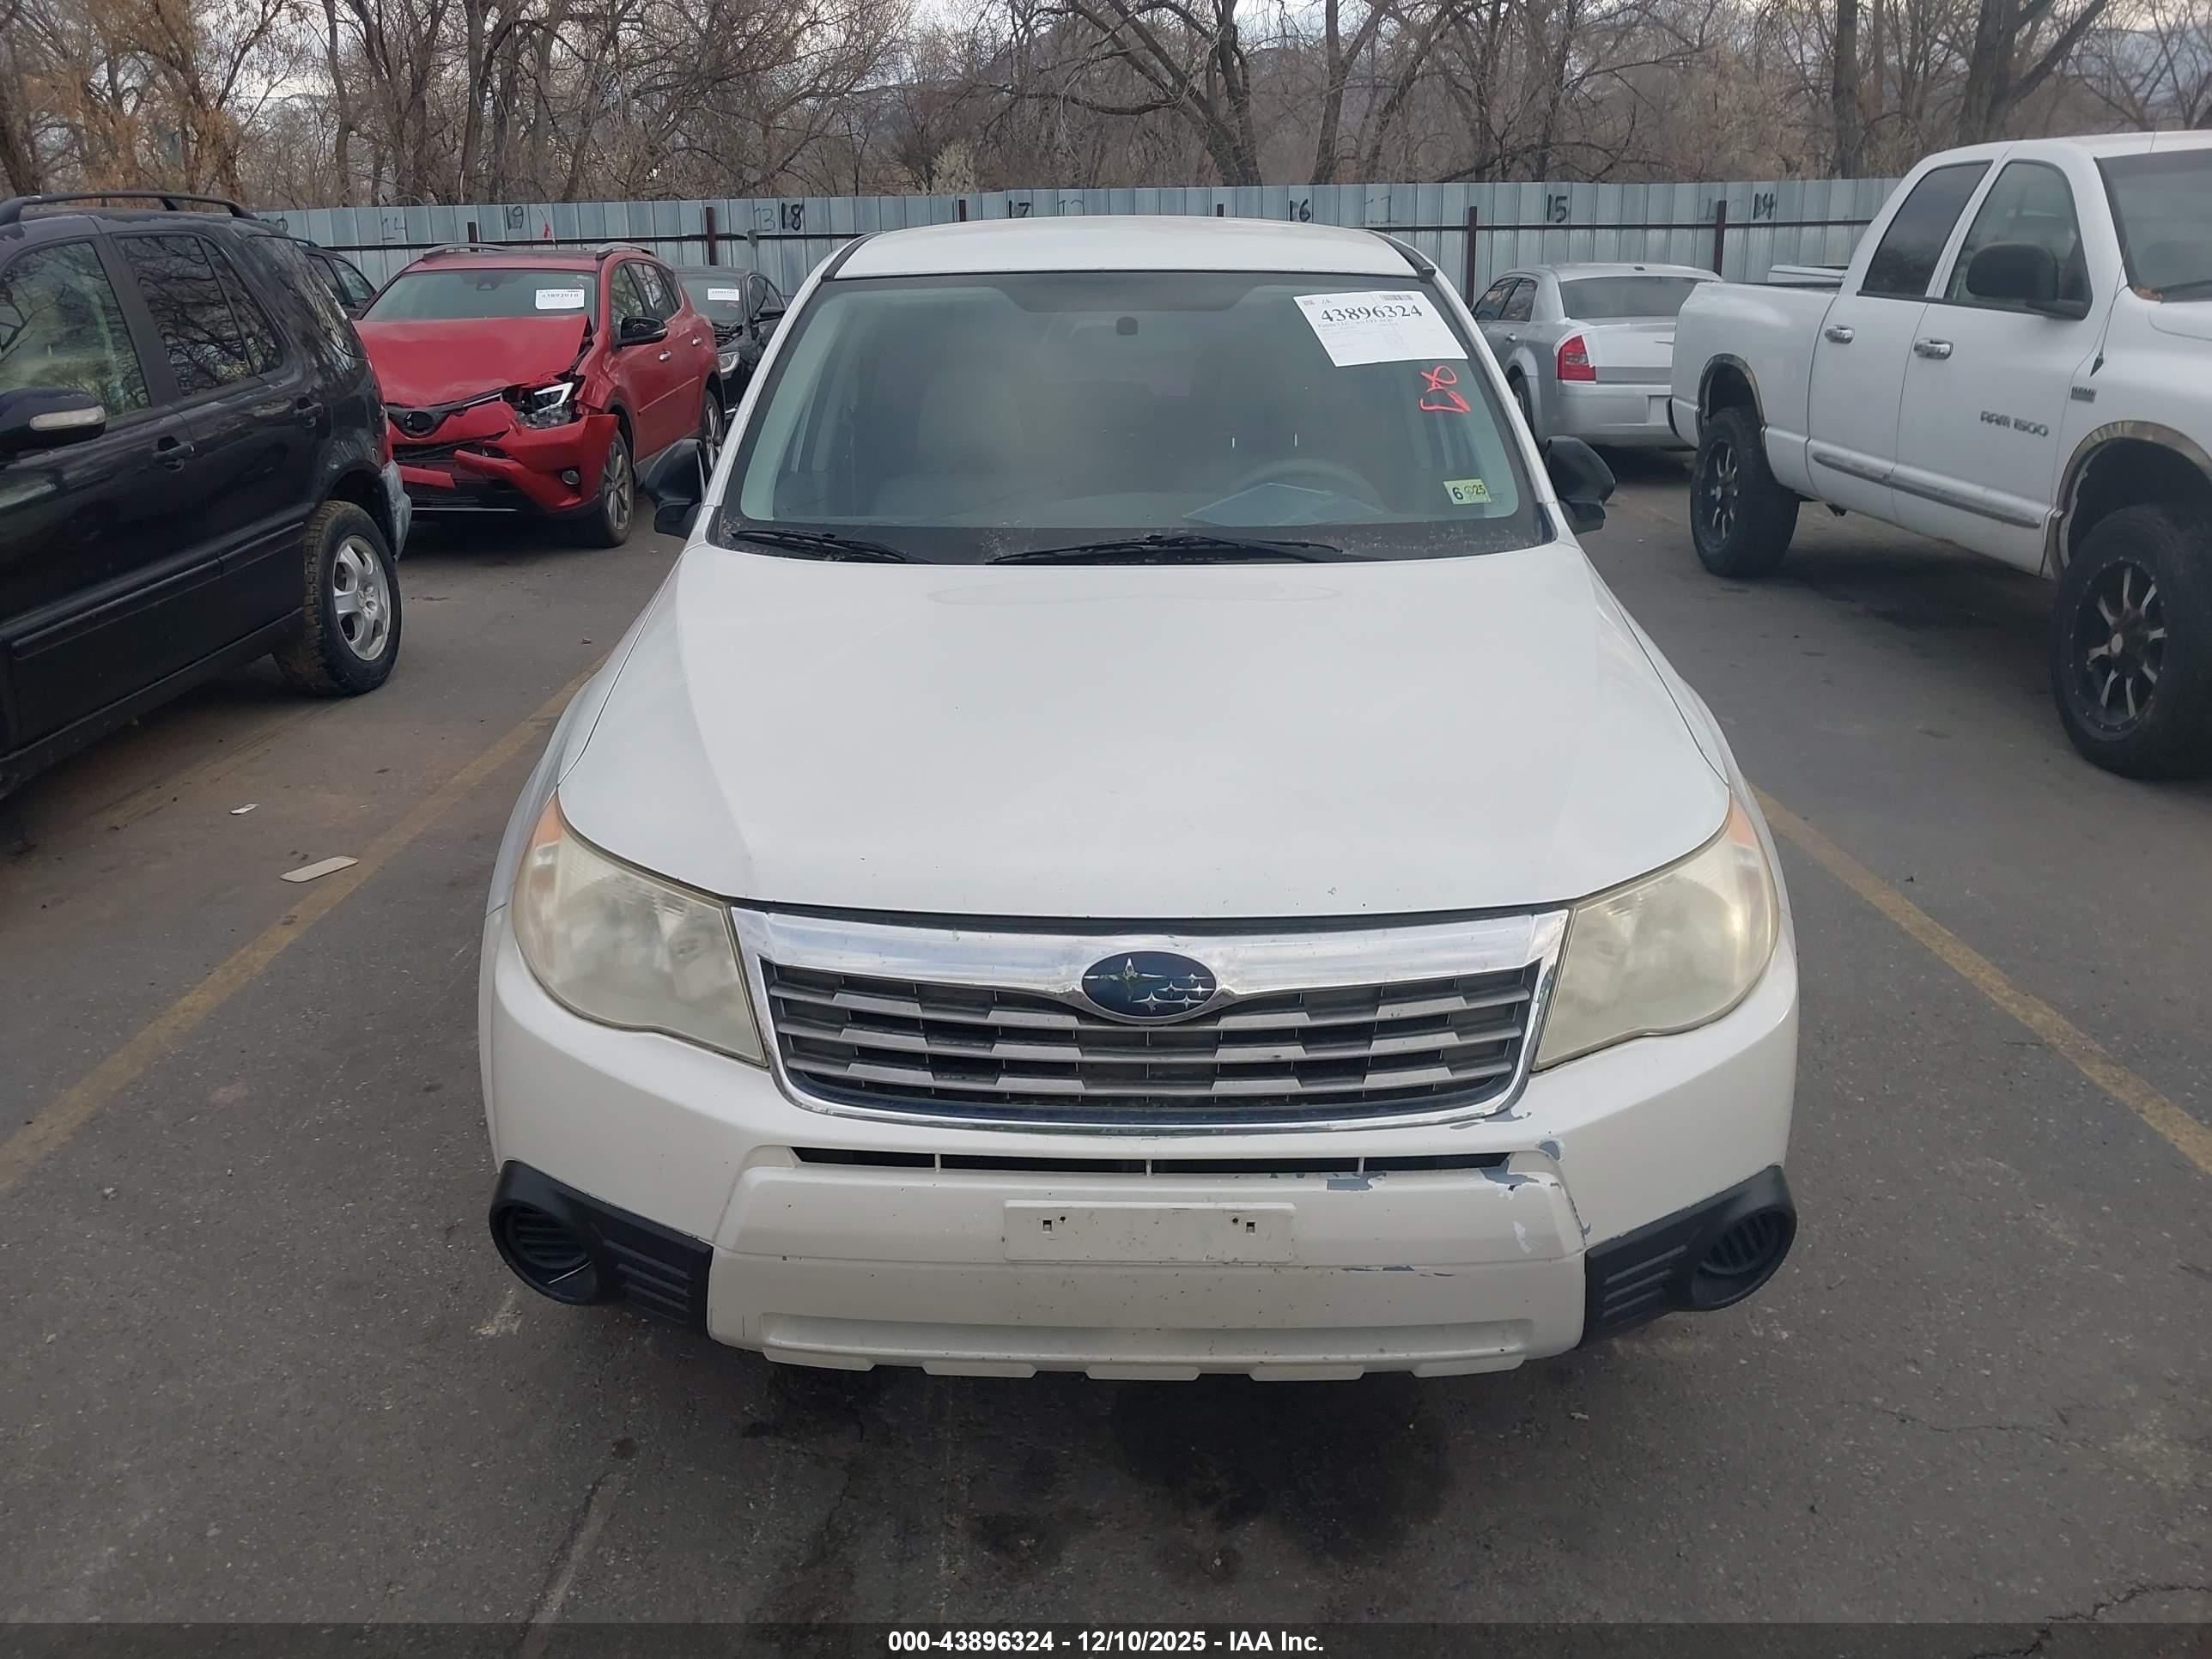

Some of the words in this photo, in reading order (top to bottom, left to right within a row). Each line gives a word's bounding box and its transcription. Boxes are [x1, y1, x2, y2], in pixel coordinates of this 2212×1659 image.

[505, 205, 525, 231] 19
[781, 201, 805, 232] 18
[1008, 199, 1031, 218] 17
[1288, 198, 1310, 222] 16
[1547, 193, 1568, 223] 15
[1753, 192, 1775, 221] 14
[754, 208, 776, 232] 13
[1321, 303, 1423, 322] 43896324
[1980, 410, 2011, 428] RAM
[2013, 417, 2049, 437] 1500
[1451, 486, 1464, 501] 6
[1472, 484, 1486, 495] 25
